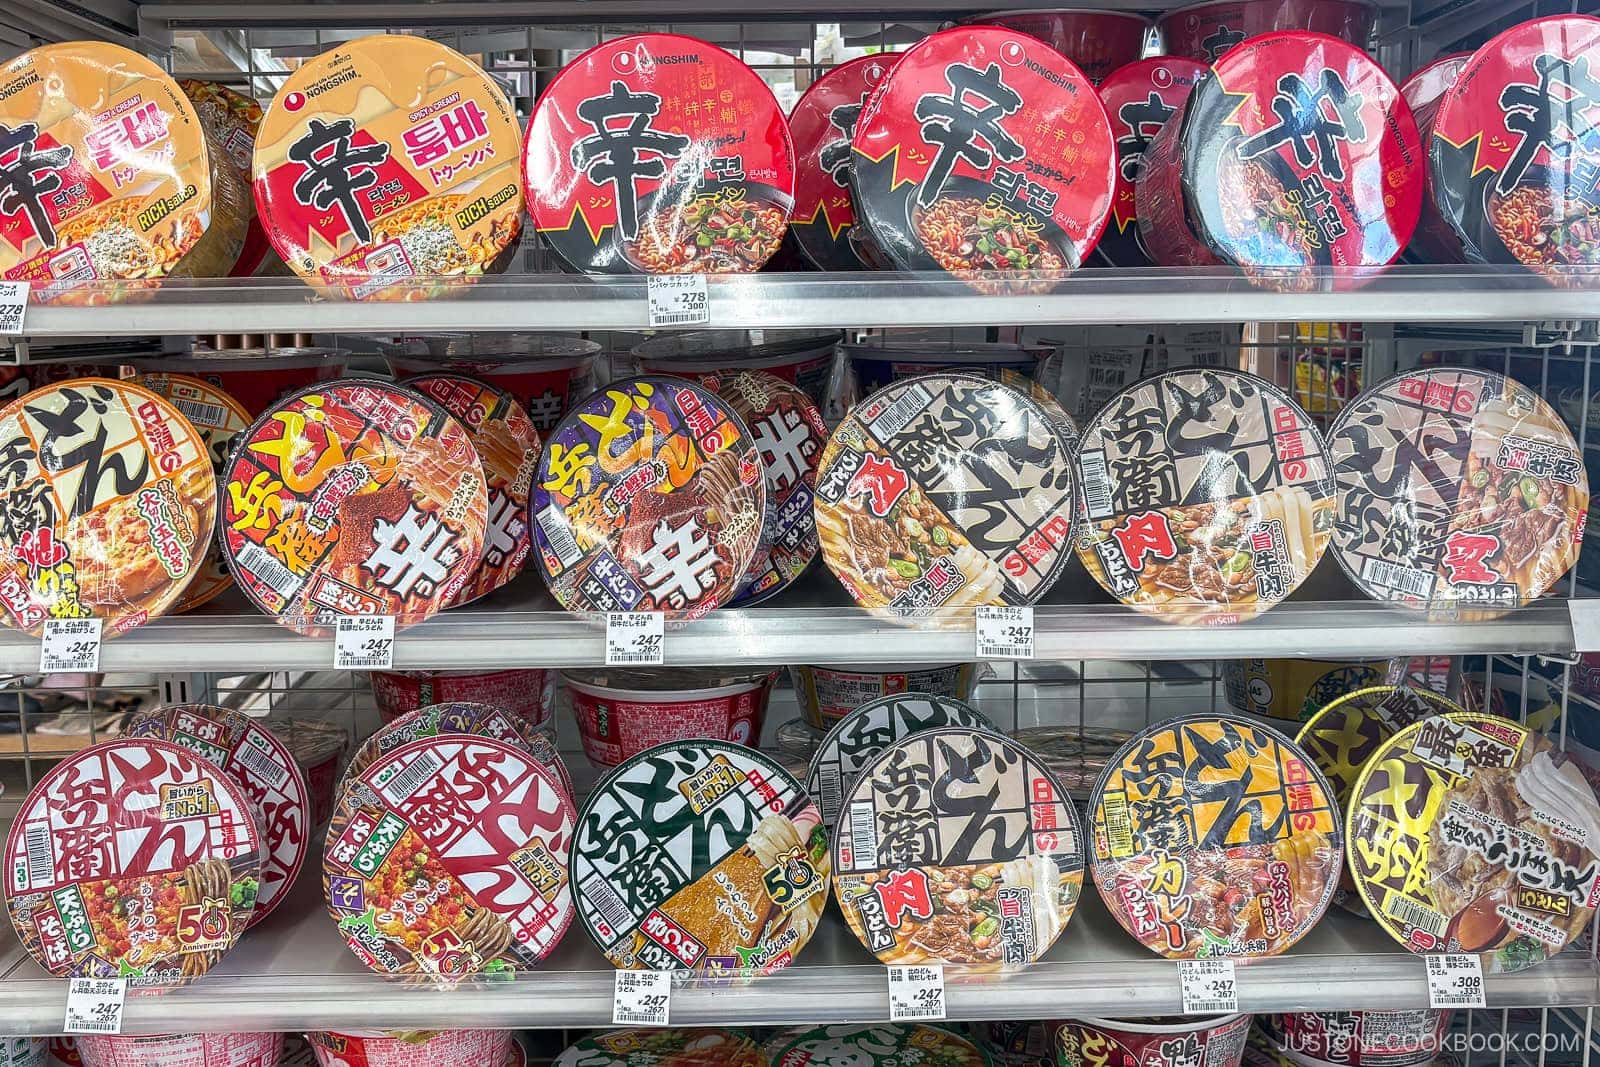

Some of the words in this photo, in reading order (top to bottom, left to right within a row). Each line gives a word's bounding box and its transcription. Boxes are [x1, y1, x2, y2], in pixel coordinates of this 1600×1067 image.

[0, 75, 41, 100] ONGSHIM
[306, 70, 358, 99] NONGSHIM
[1024, 58, 1077, 94] NONGSHIM
[117, 94, 142, 114] CREAMY
[409, 107, 429, 122] SPICY
[434, 92, 461, 111] CREAMY
[1236, 67, 1367, 183] 辛
[401, 101, 489, 169] 툼바
[907, 149, 929, 166] シン
[913, 62, 1026, 209] 辛
[1382, 108, 1413, 168] NONGSHIM
[1489, 135, 1511, 153] シン
[287, 117, 391, 245] 辛
[570, 80, 691, 242] 辛
[137, 201, 169, 232] RICH
[167, 185, 198, 210] sauce
[367, 179, 403, 202] 라면
[373, 193, 410, 216] ラーメン
[455, 201, 488, 230] RICH
[487, 184, 518, 209] sauce
[589, 196, 612, 209] シン
[990, 165, 1059, 217] 라면
[1300, 172, 1347, 244] 라면
[5, 219, 21, 232] シン
[319, 215, 335, 228] シン
[1398, 377, 1475, 413] 日清の
[137, 401, 184, 473] 日清の
[674, 388, 726, 455] 日清の
[1165, 369, 1275, 506] どん
[1273, 405, 1308, 481] 日清の
[25, 384, 148, 520] どん
[819, 453, 860, 500] うどん
[1099, 395, 1175, 512] 兵衛
[362, 502, 462, 602] 辛
[640, 515, 725, 608] 辛
[1004, 515, 1070, 577] 日清の
[691, 595, 719, 620] NISSIN
[175, 792, 210, 818] No.1
[703, 773, 737, 803] No.1
[748, 768, 785, 813] 日清の
[872, 749, 937, 870] 兵衛
[931, 735, 1030, 865] どん
[1182, 720, 1285, 850] どん
[1287, 759, 1316, 832] 日清の
[50, 765, 111, 878] 兵衛
[109, 747, 206, 877] どん
[219, 809, 238, 859] 日清の
[614, 750, 752, 881] どん
[1032, 777, 1059, 851] 日清の
[334, 818, 371, 863] そば
[357, 815, 403, 874] 天ぷら
[841, 848, 851, 862] 5
[16, 868, 27, 883] 3
[520, 856, 560, 896] No.1
[782, 880, 824, 912] Anniversary
[56, 888, 91, 947] 天ぷら
[140, 882, 159, 943] あとのせ
[515, 904, 559, 942] 日清の
[863, 896, 891, 949] うどん
[1124, 883, 1156, 933] うどん
[1147, 851, 1191, 950] カレー
[40, 915, 69, 963] そば
[349, 940, 374, 966] NISSIN
[647, 915, 700, 962] きつね
[751, 928, 800, 970] 北のどん兵衛
[1209, 940, 1267, 958] 北のどん兵衛
[1411, 928, 1436, 950] 8
